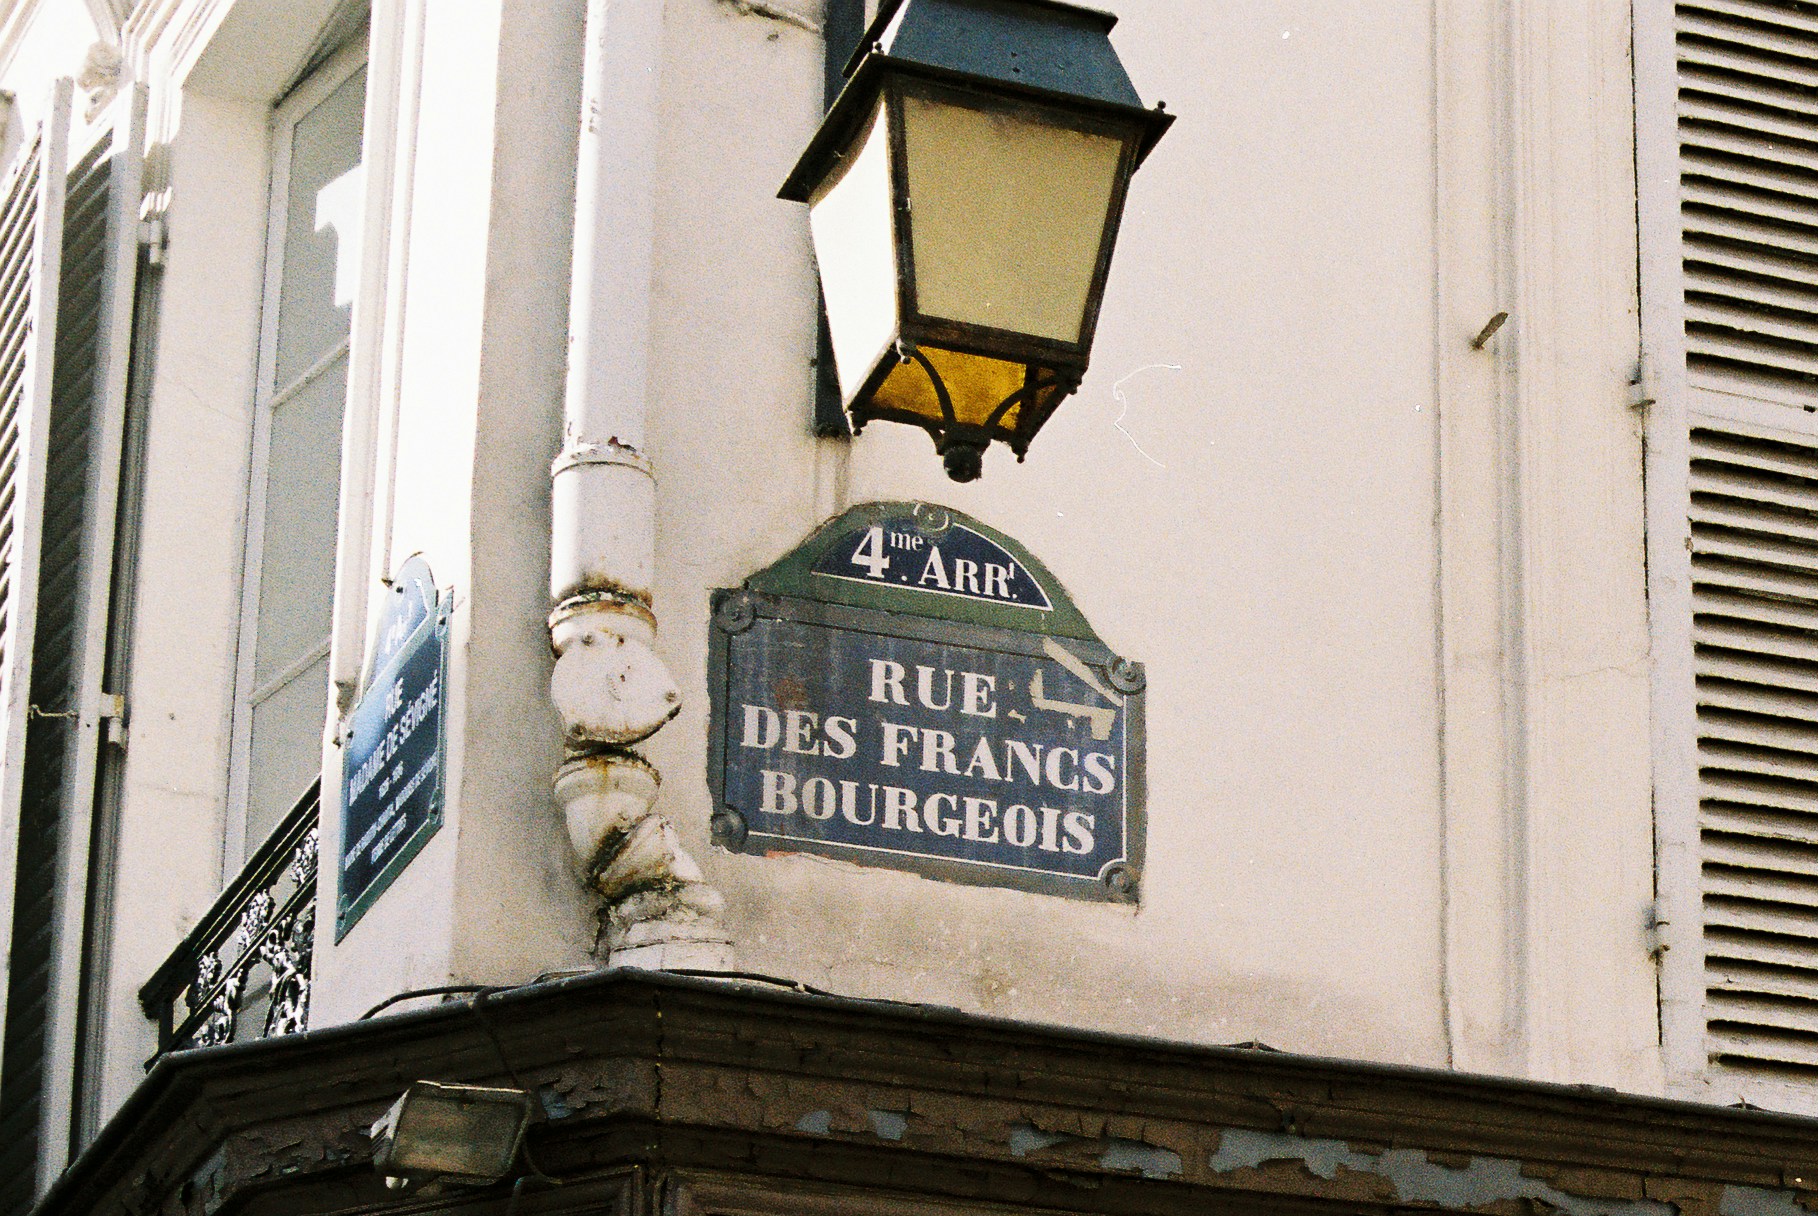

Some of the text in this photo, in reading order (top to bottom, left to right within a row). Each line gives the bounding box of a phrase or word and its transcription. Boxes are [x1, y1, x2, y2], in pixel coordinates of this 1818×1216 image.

[868, 658, 997, 719] RUE
[740, 703, 1116, 795] DES FRANCS
[758, 769, 1096, 855] BOURGEOIS
